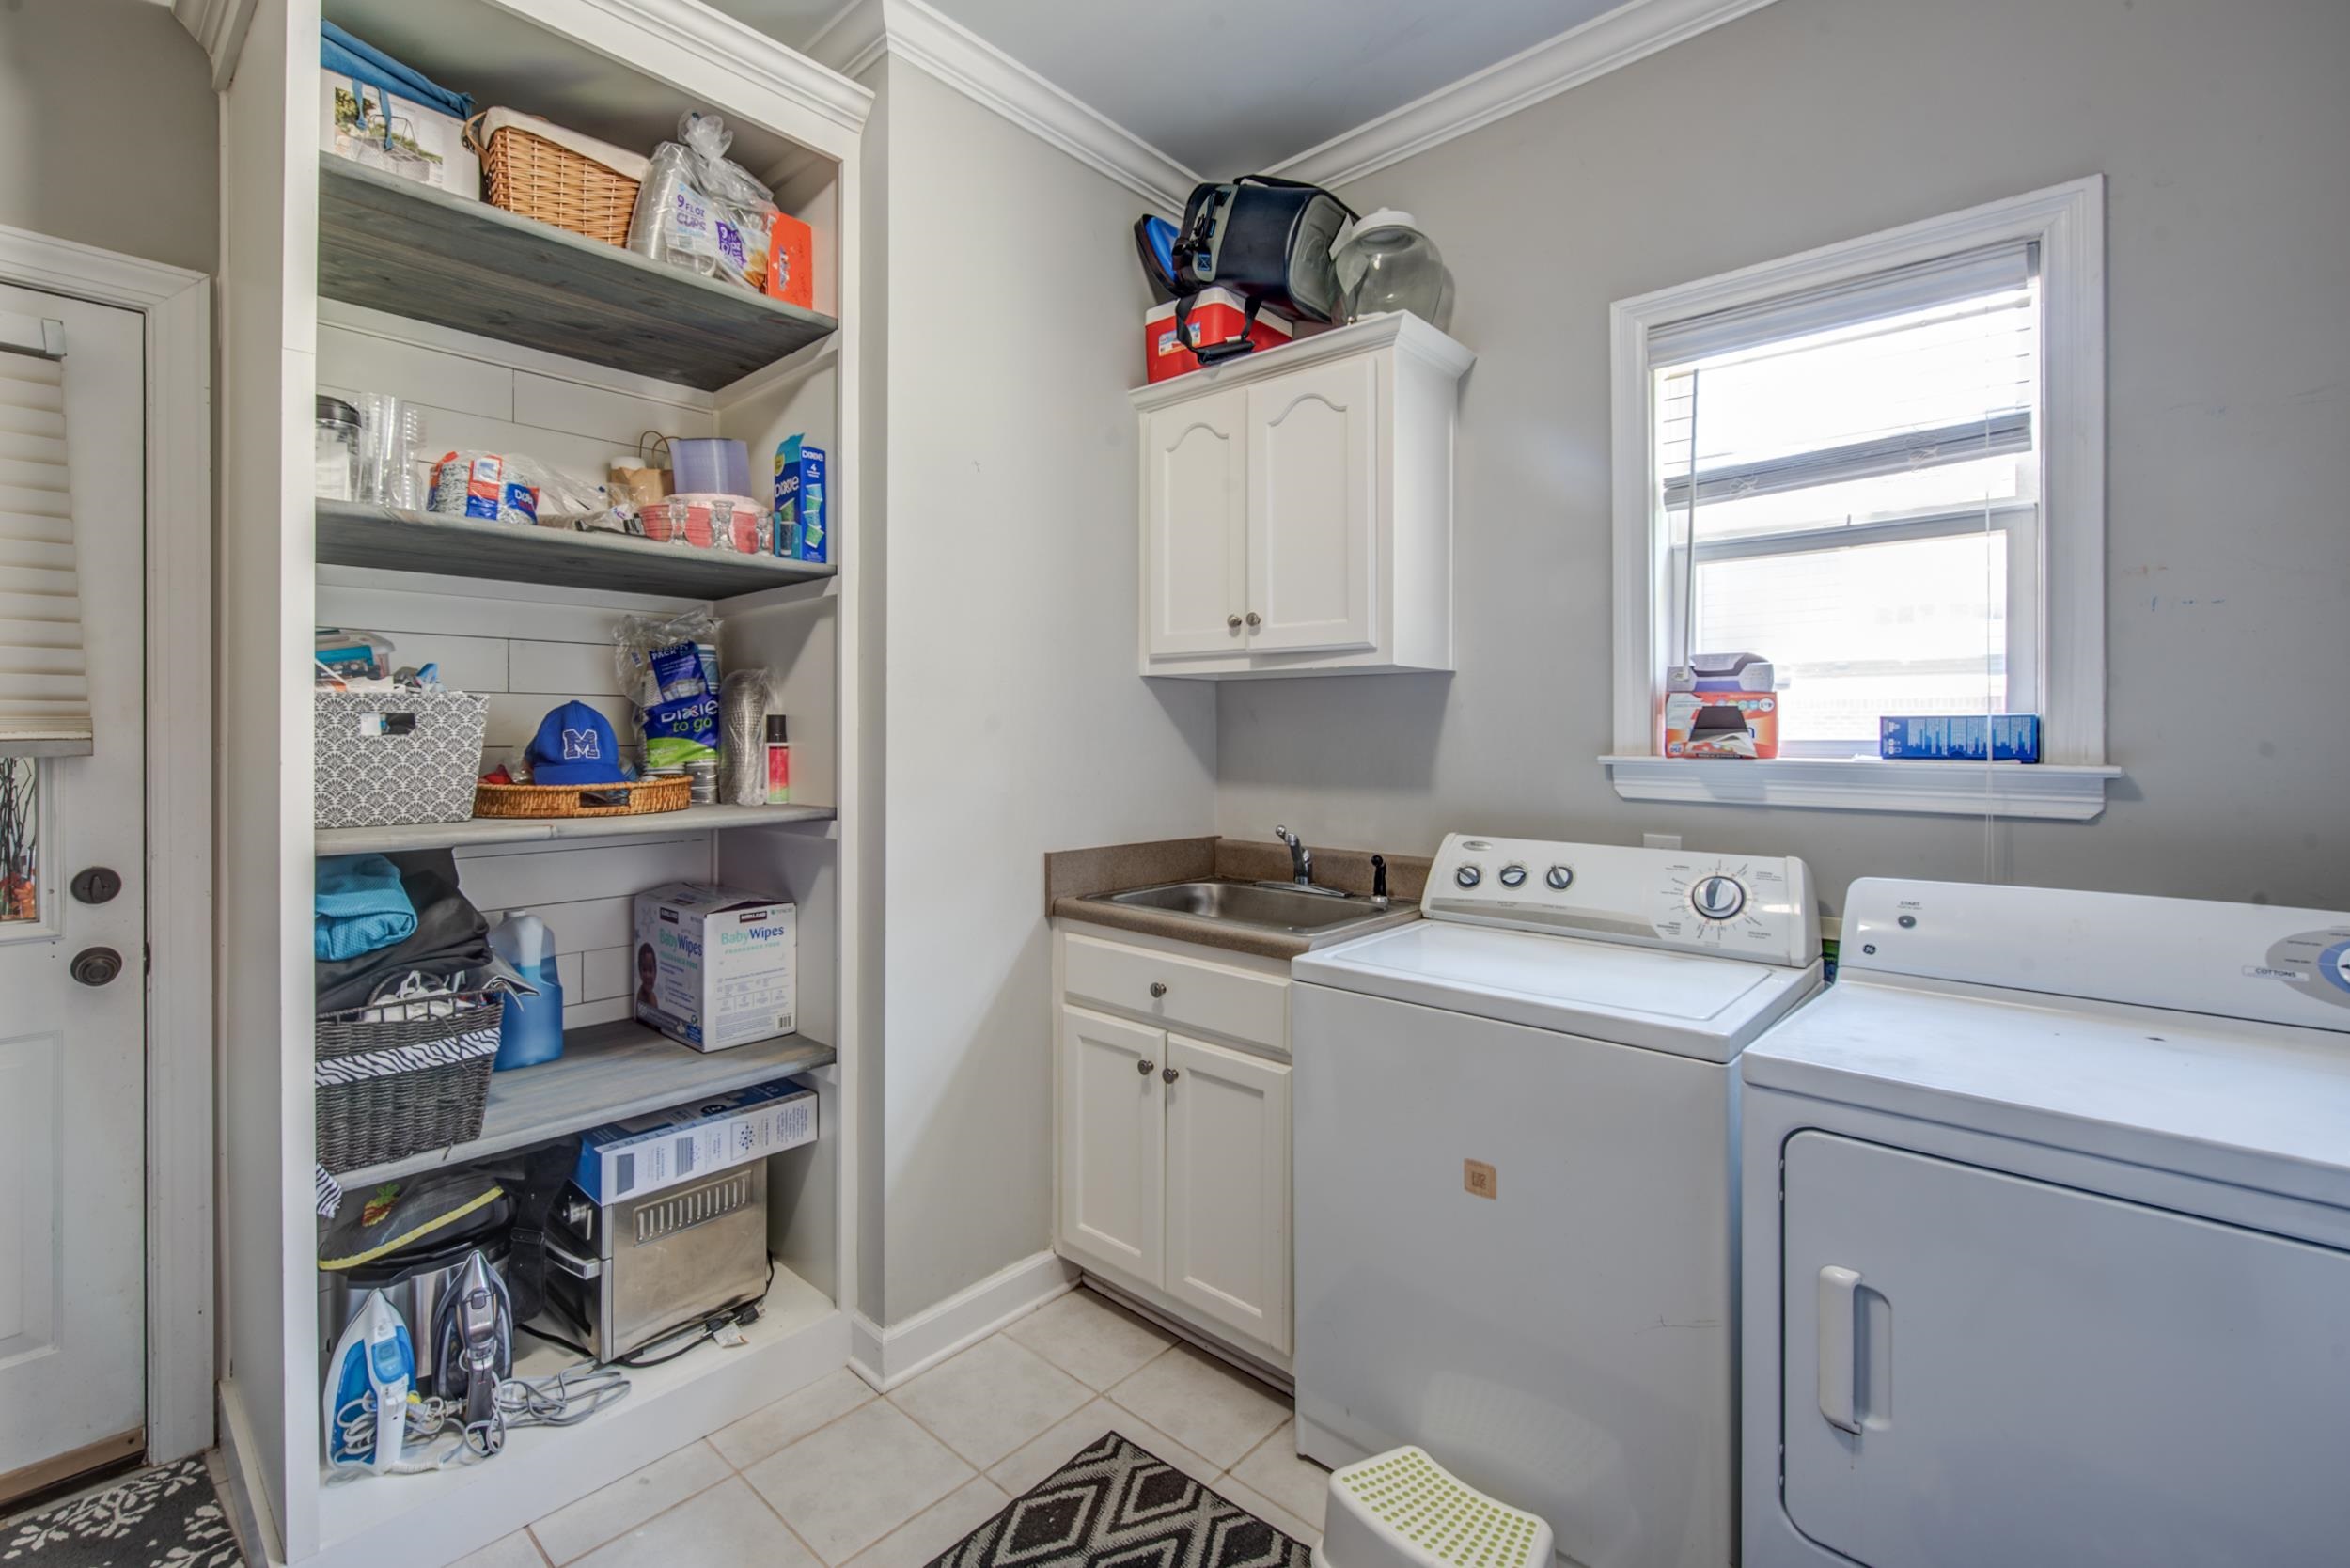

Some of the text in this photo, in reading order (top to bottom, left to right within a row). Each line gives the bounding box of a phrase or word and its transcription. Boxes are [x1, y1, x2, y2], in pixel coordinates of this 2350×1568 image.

[677, 194, 685, 208] 9
[676, 212, 706, 231] CUPS
[672, 716, 713, 733] to go
[562, 729, 600, 760] M
[2255, 967, 2297, 979] COTTONS
